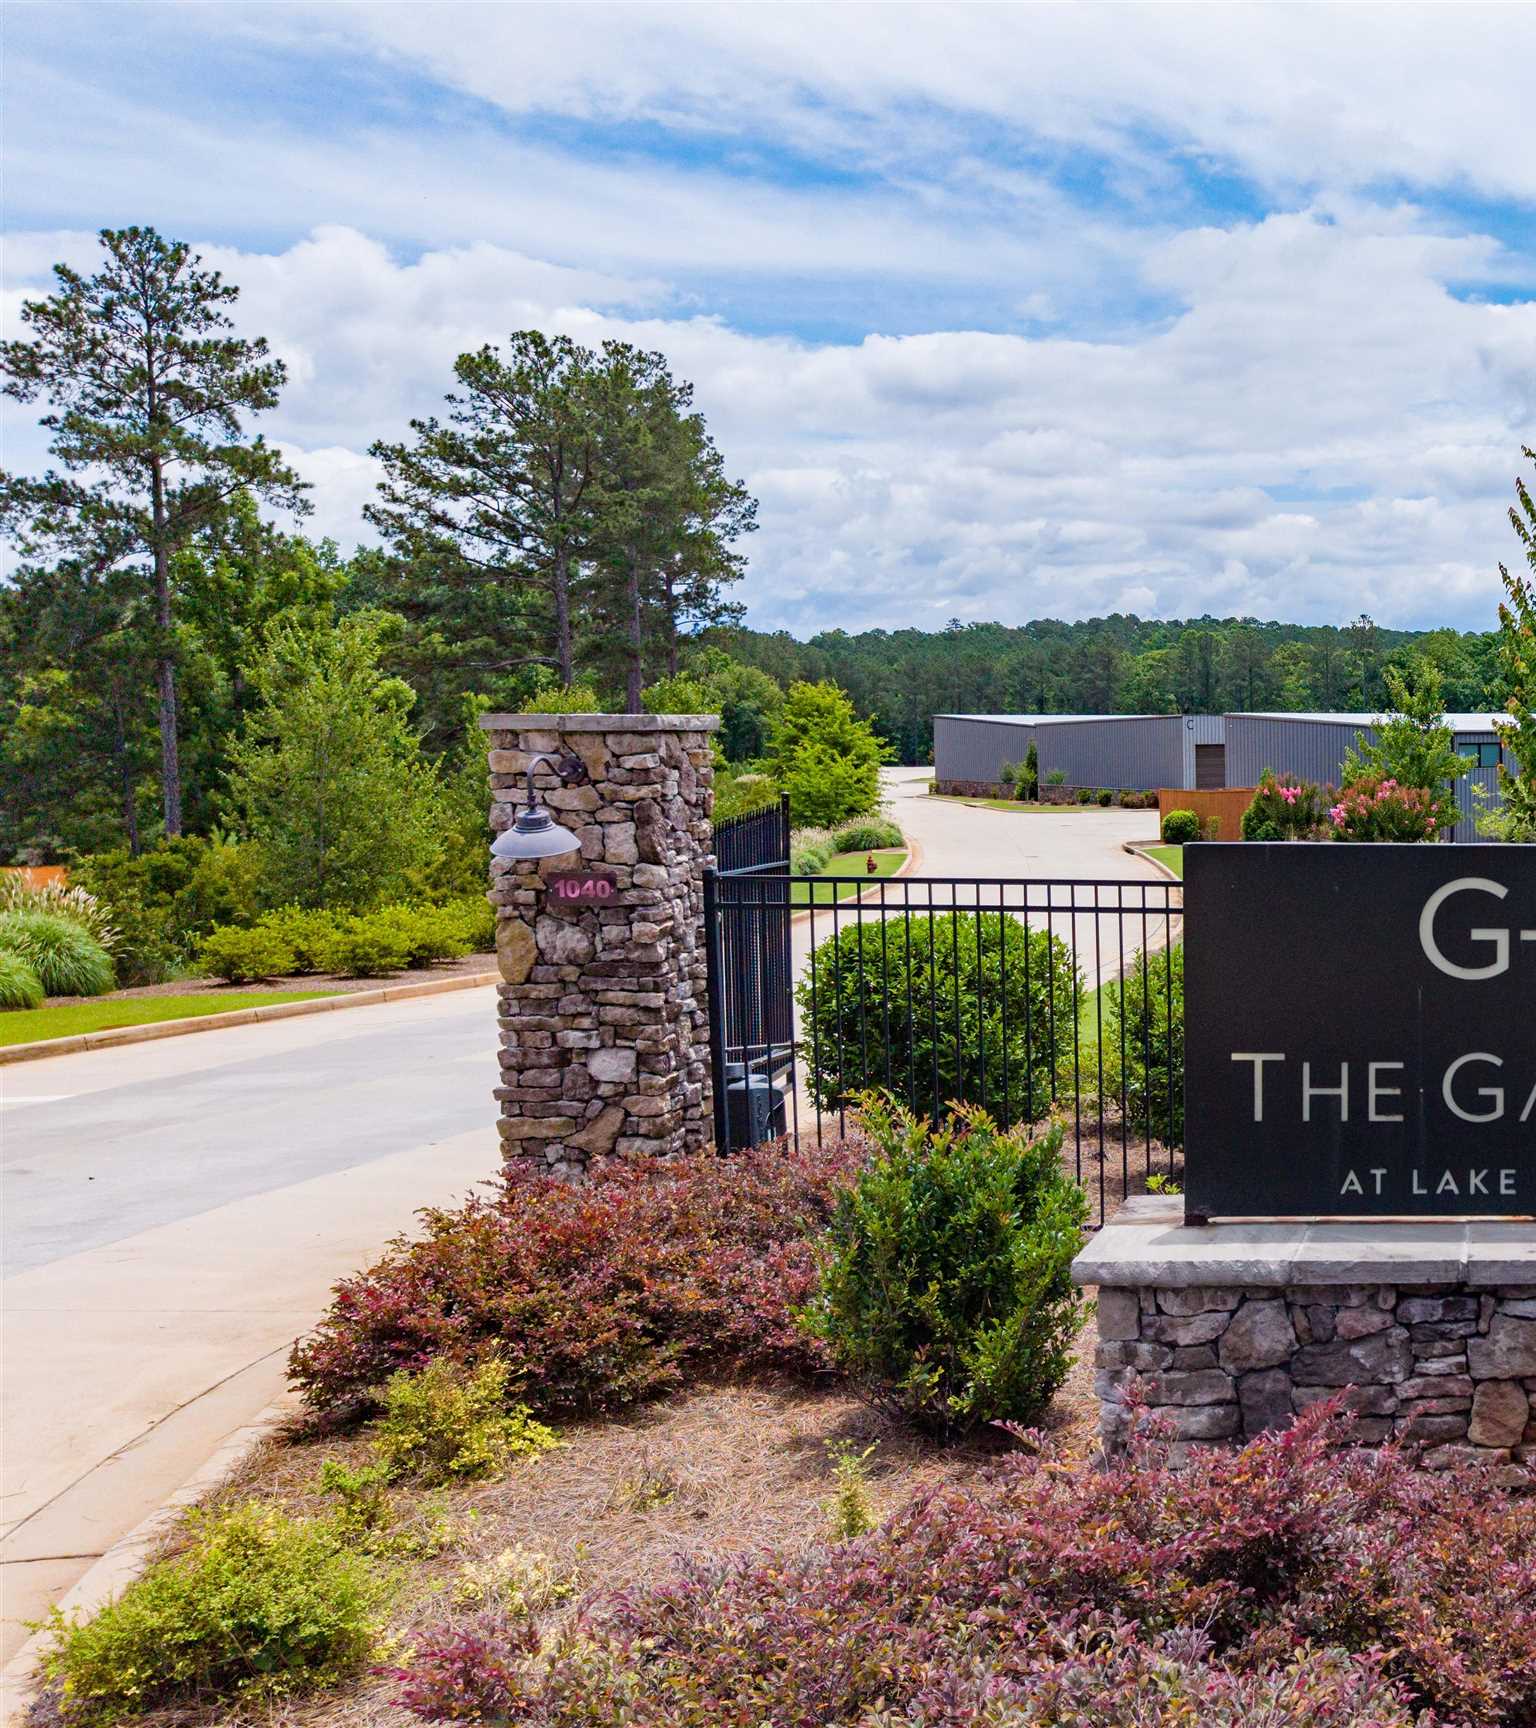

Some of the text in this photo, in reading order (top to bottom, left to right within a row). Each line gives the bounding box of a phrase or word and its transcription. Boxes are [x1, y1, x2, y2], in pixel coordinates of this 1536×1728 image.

[1186, 719, 1194, 730] C
[554, 879, 611, 898] 1040
[1418, 877, 1510, 980] G
[1230, 1052, 1404, 1123] THE
[1340, 1168, 1387, 1195] AT
[1412, 1169, 1516, 1195] LAKE
